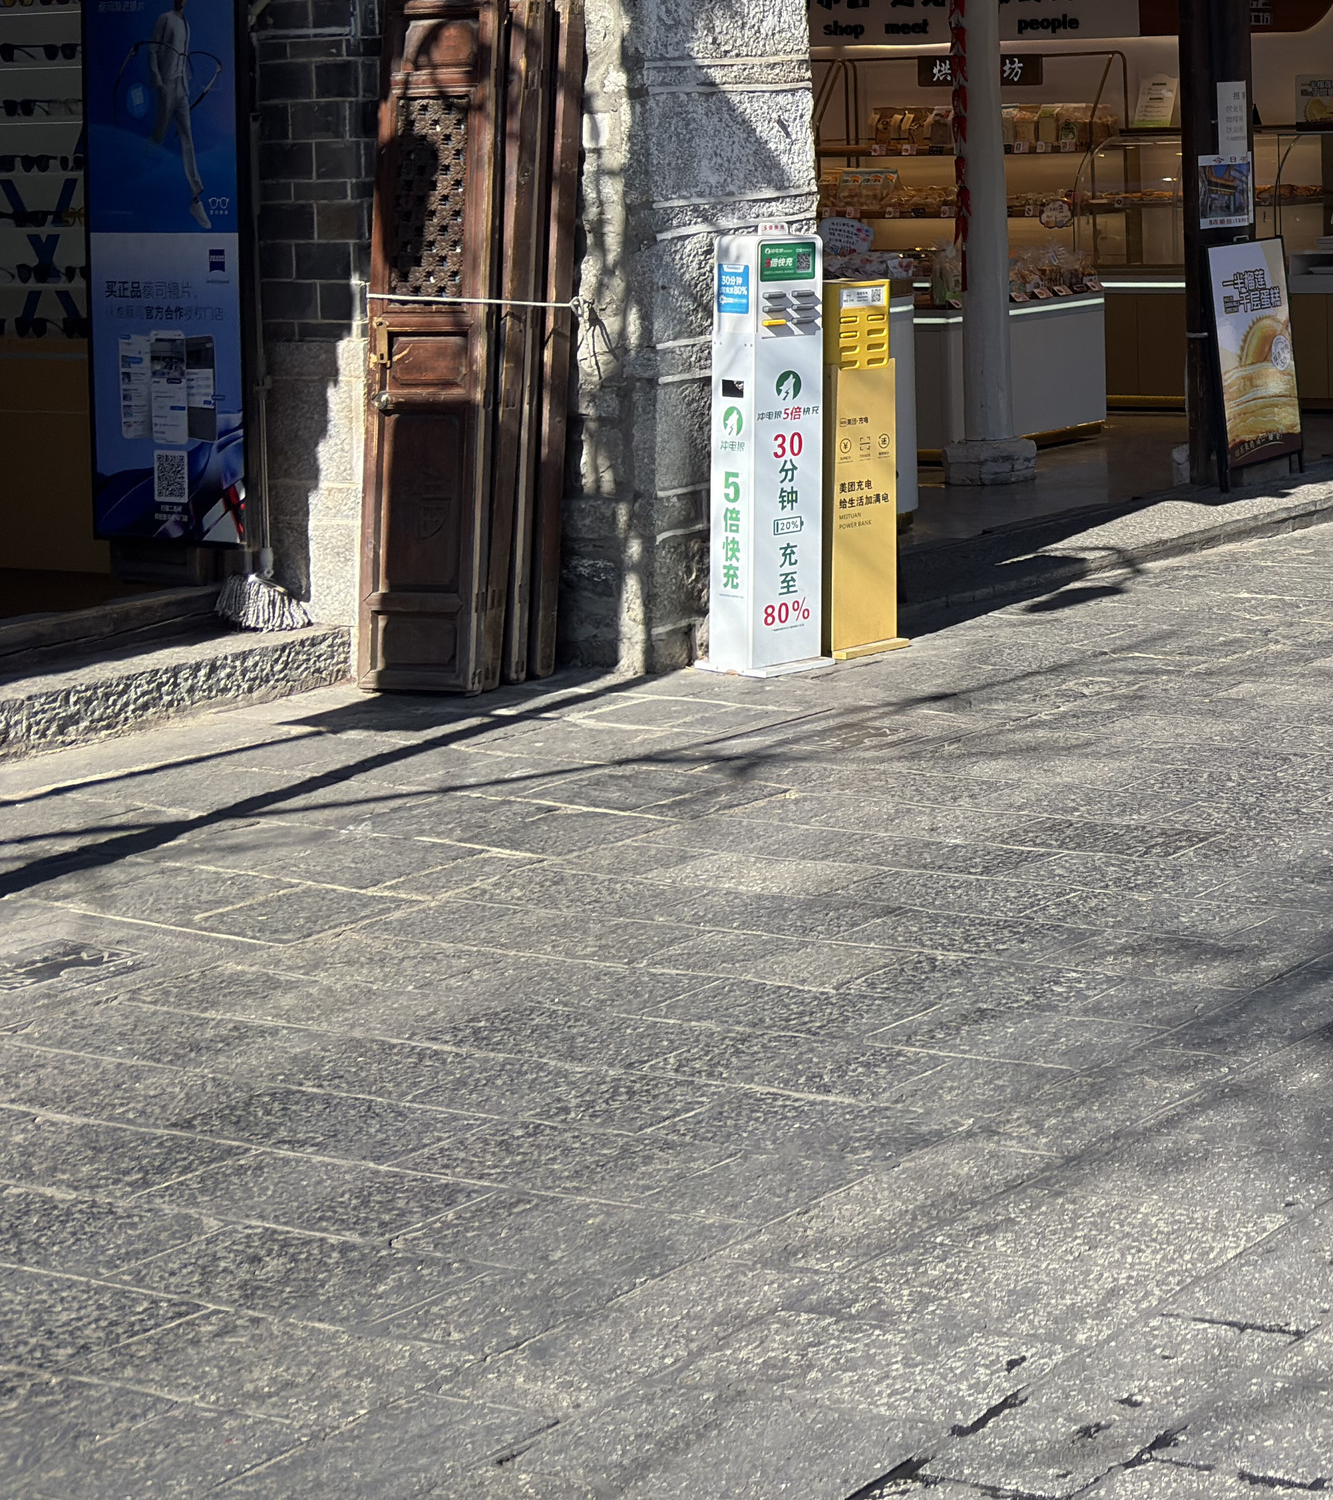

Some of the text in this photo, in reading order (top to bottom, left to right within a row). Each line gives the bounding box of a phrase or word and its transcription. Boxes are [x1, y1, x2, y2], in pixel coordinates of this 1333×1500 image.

[823, 13, 1080, 38] shop meet people
[839, 479, 873, 495] 美团充电
[839, 493, 889, 510] 给生活加满电
[839, 512, 862, 521] MEITUAN
[858, 520, 873, 528] BANK
[722, 471, 741, 590] 5倍快充
[780, 520, 799, 531] 20%
